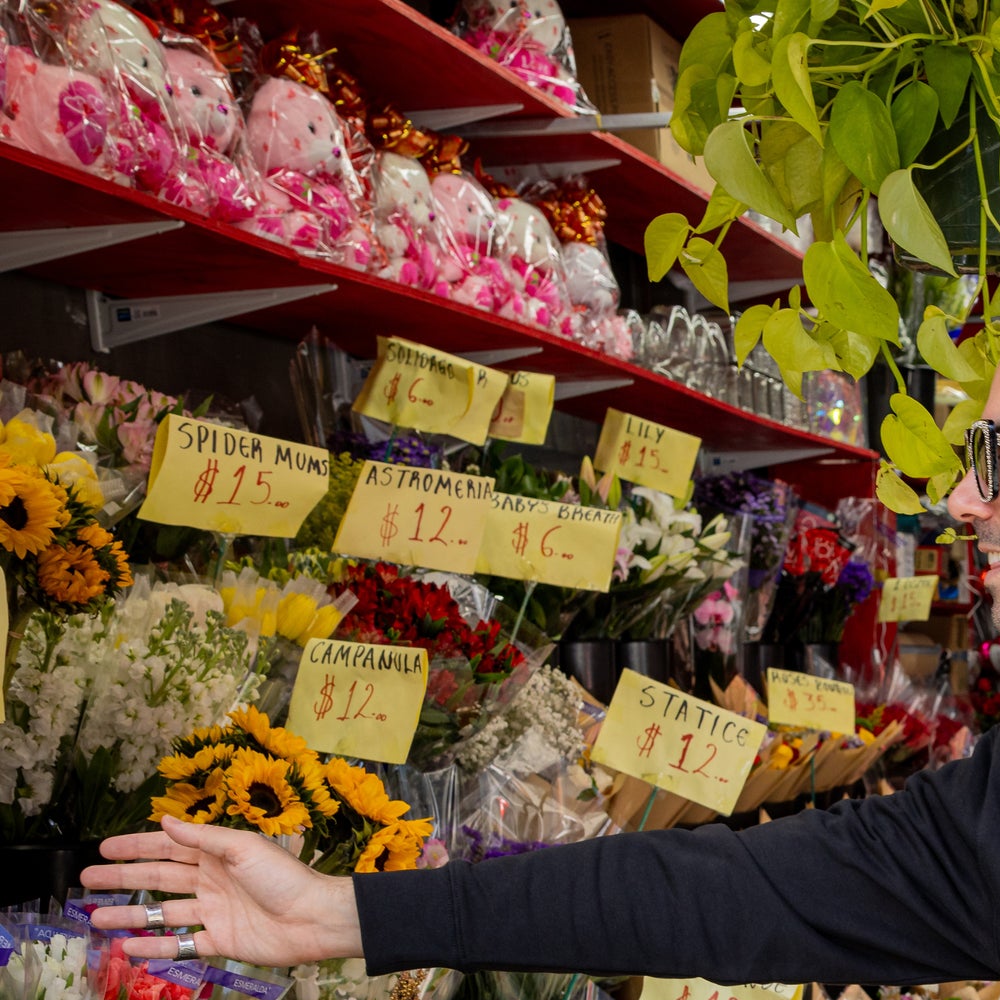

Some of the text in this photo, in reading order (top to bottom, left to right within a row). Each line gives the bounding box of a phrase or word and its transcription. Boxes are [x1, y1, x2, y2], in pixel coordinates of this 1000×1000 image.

[626, 416, 666, 444] LILY
[178, 422, 330, 477] SPIDER MUMS
[365, 466, 495, 500] ASTROMERIA
[310, 641, 422, 674] CAMPANULA
[639, 685, 749, 747] STATICE
